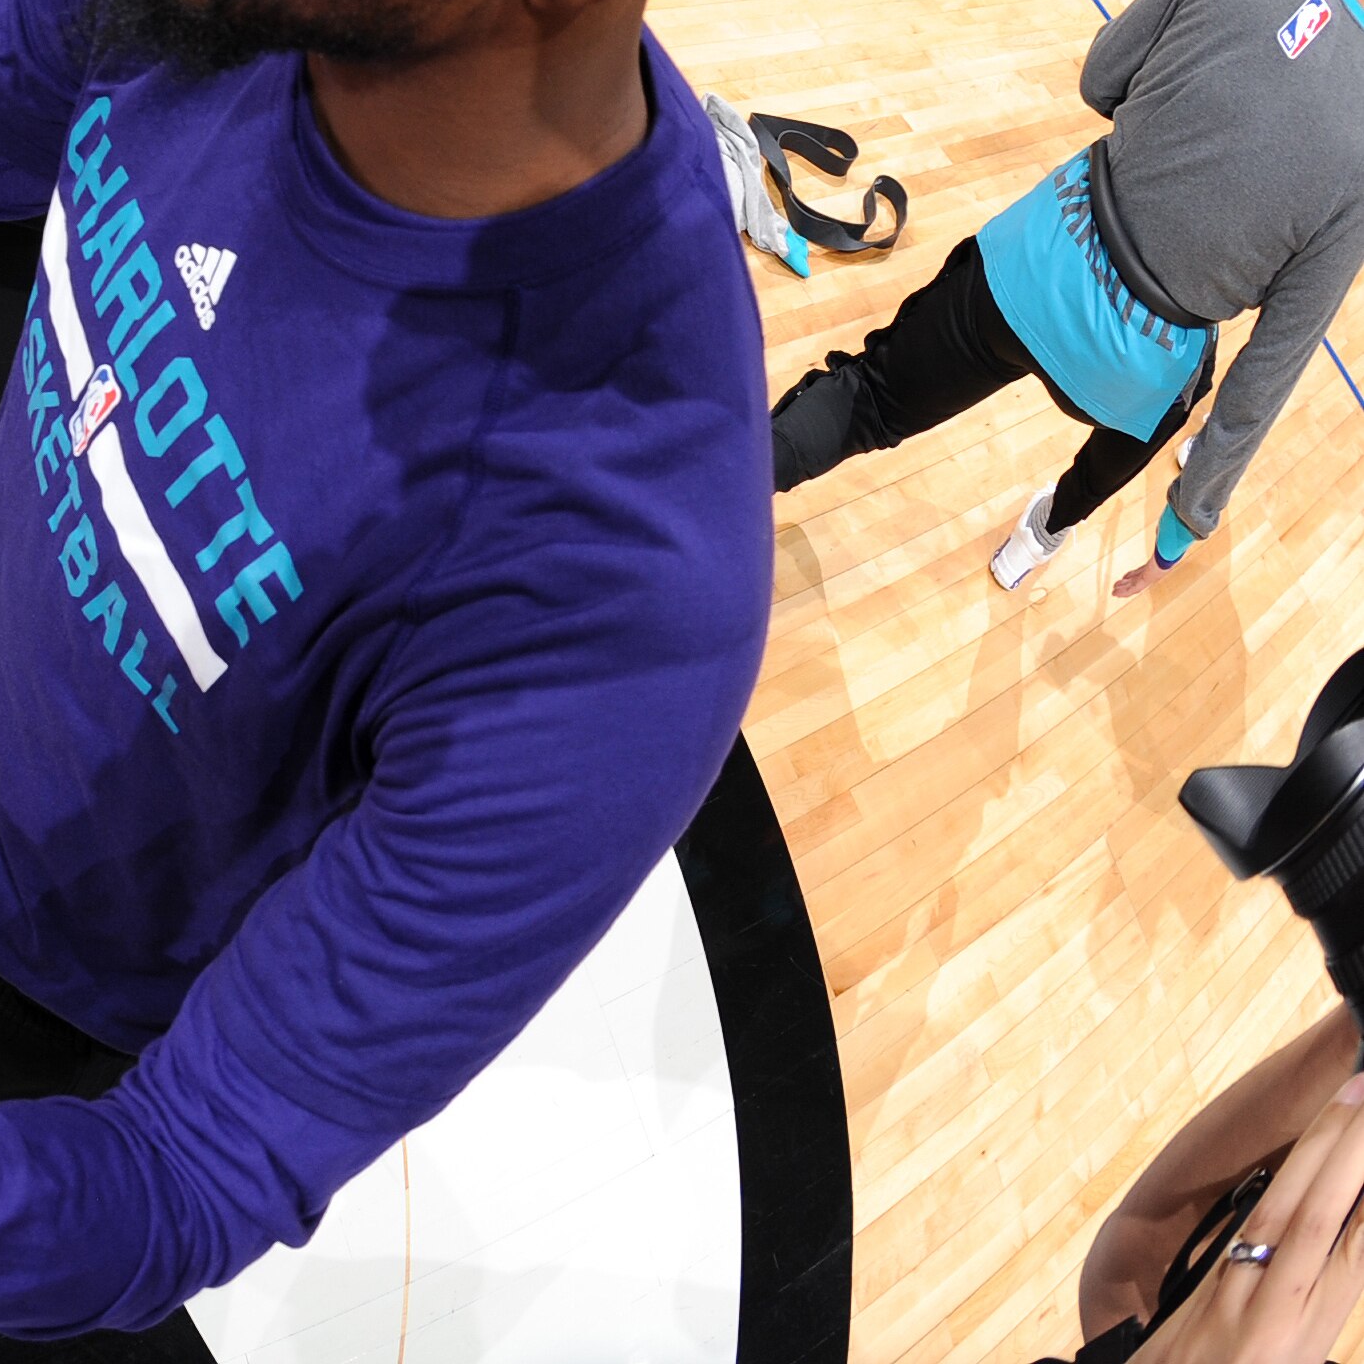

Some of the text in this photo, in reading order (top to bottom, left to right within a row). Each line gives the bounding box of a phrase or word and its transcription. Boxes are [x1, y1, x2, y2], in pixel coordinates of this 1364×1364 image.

[24, 285, 179, 735] SKETBALL
[68, 96, 304, 648] CHARLOTTE
[174, 244, 216, 331] adidas
